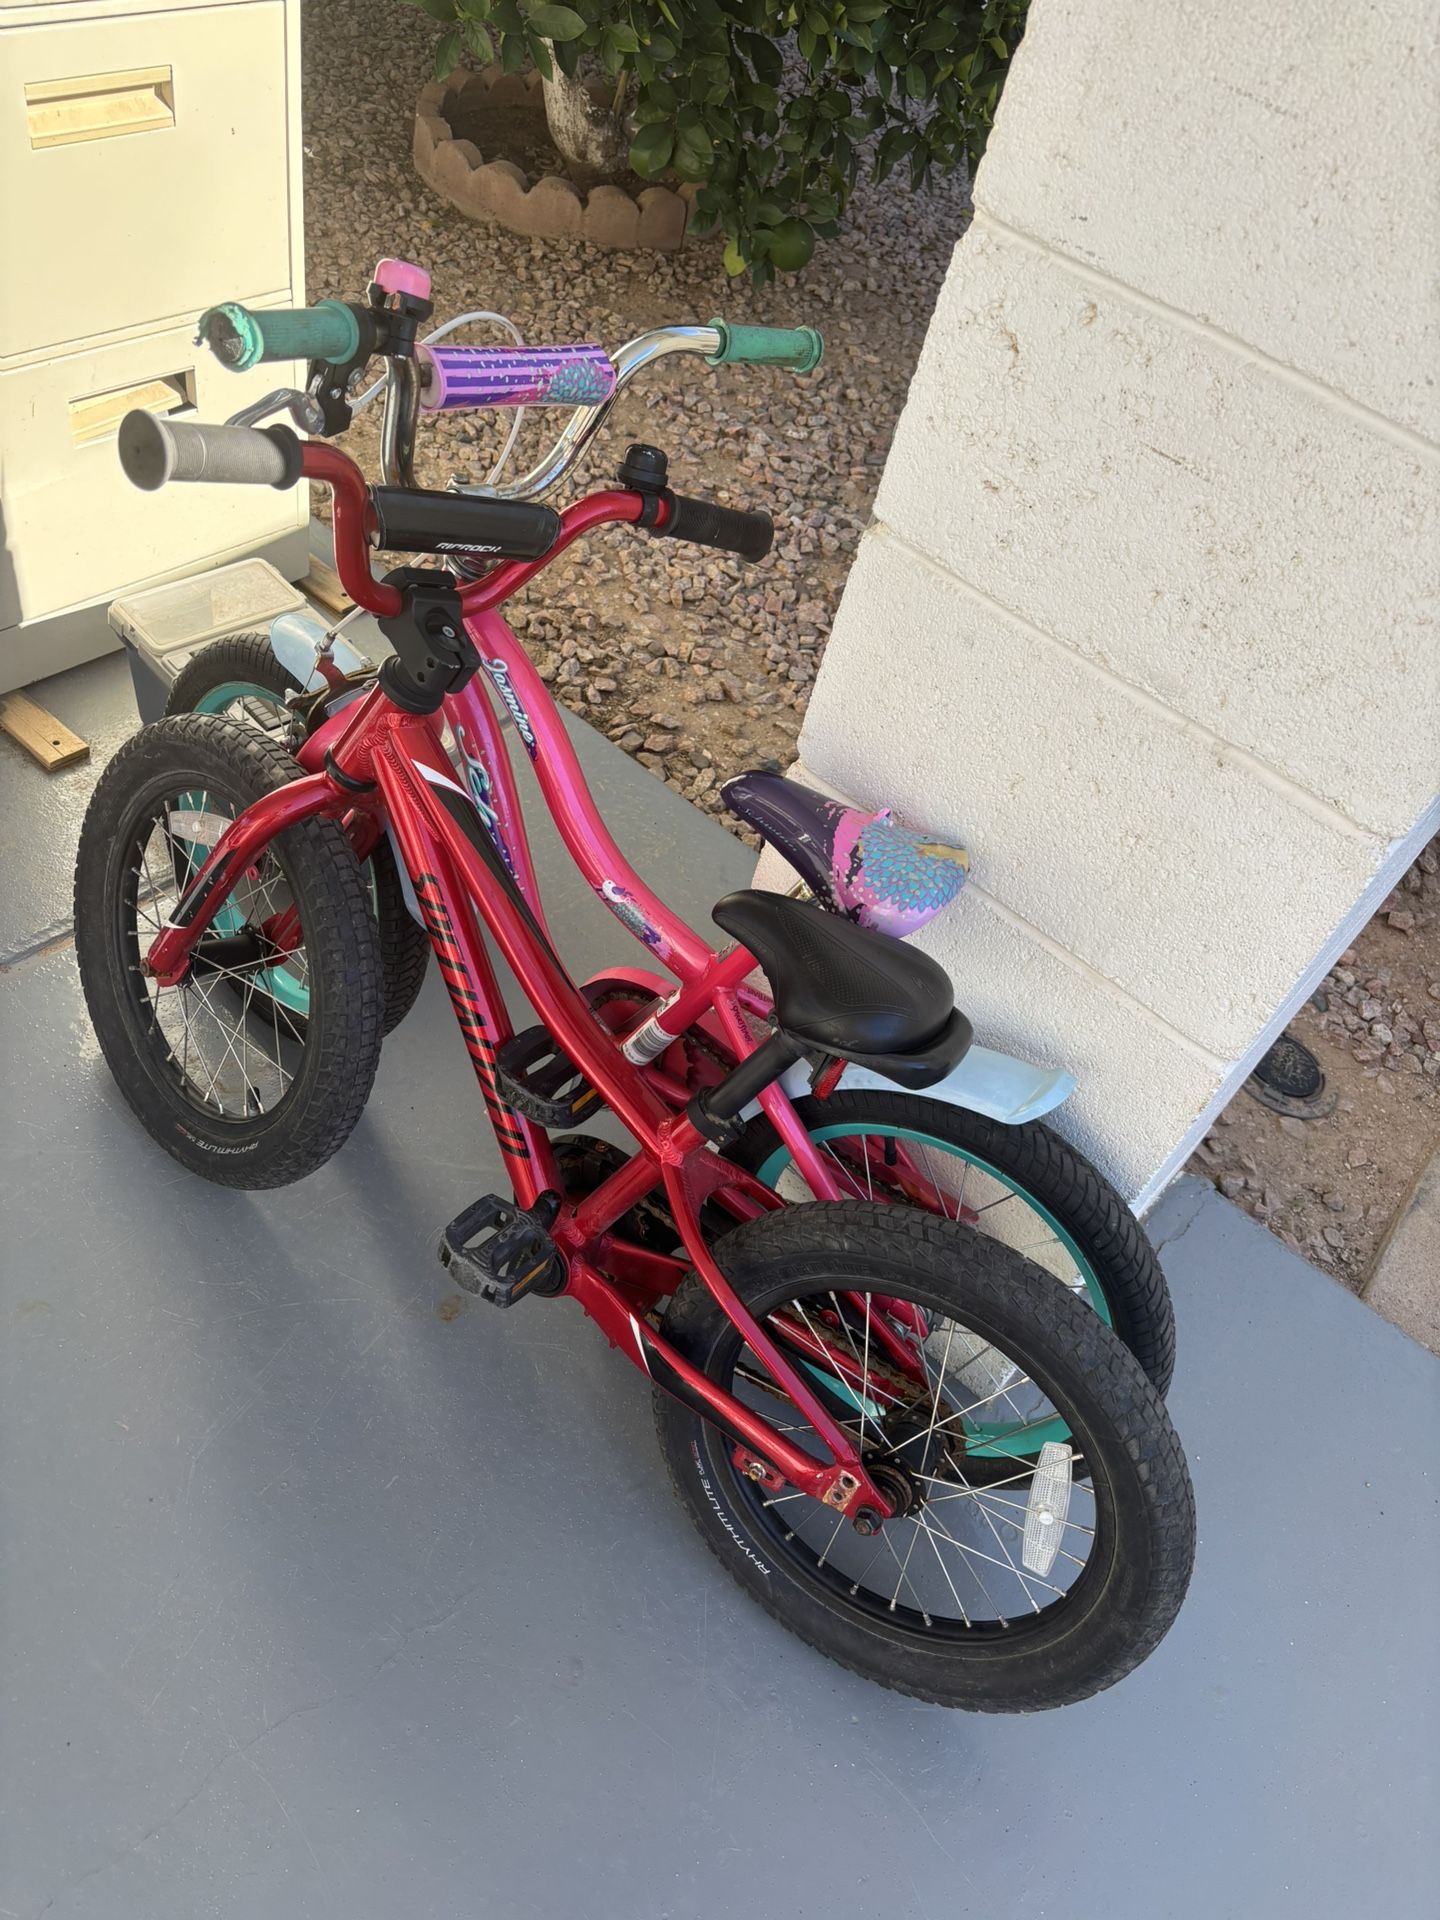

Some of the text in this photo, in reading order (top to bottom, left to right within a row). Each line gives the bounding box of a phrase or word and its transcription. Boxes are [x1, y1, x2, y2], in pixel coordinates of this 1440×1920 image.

[435, 542, 502, 553] RIPROCK
[481, 658, 534, 744] Jasmine
[195, 1139, 260, 1155] RHYTHM LITE
[700, 1478, 771, 1575] RHYTHM LITE
